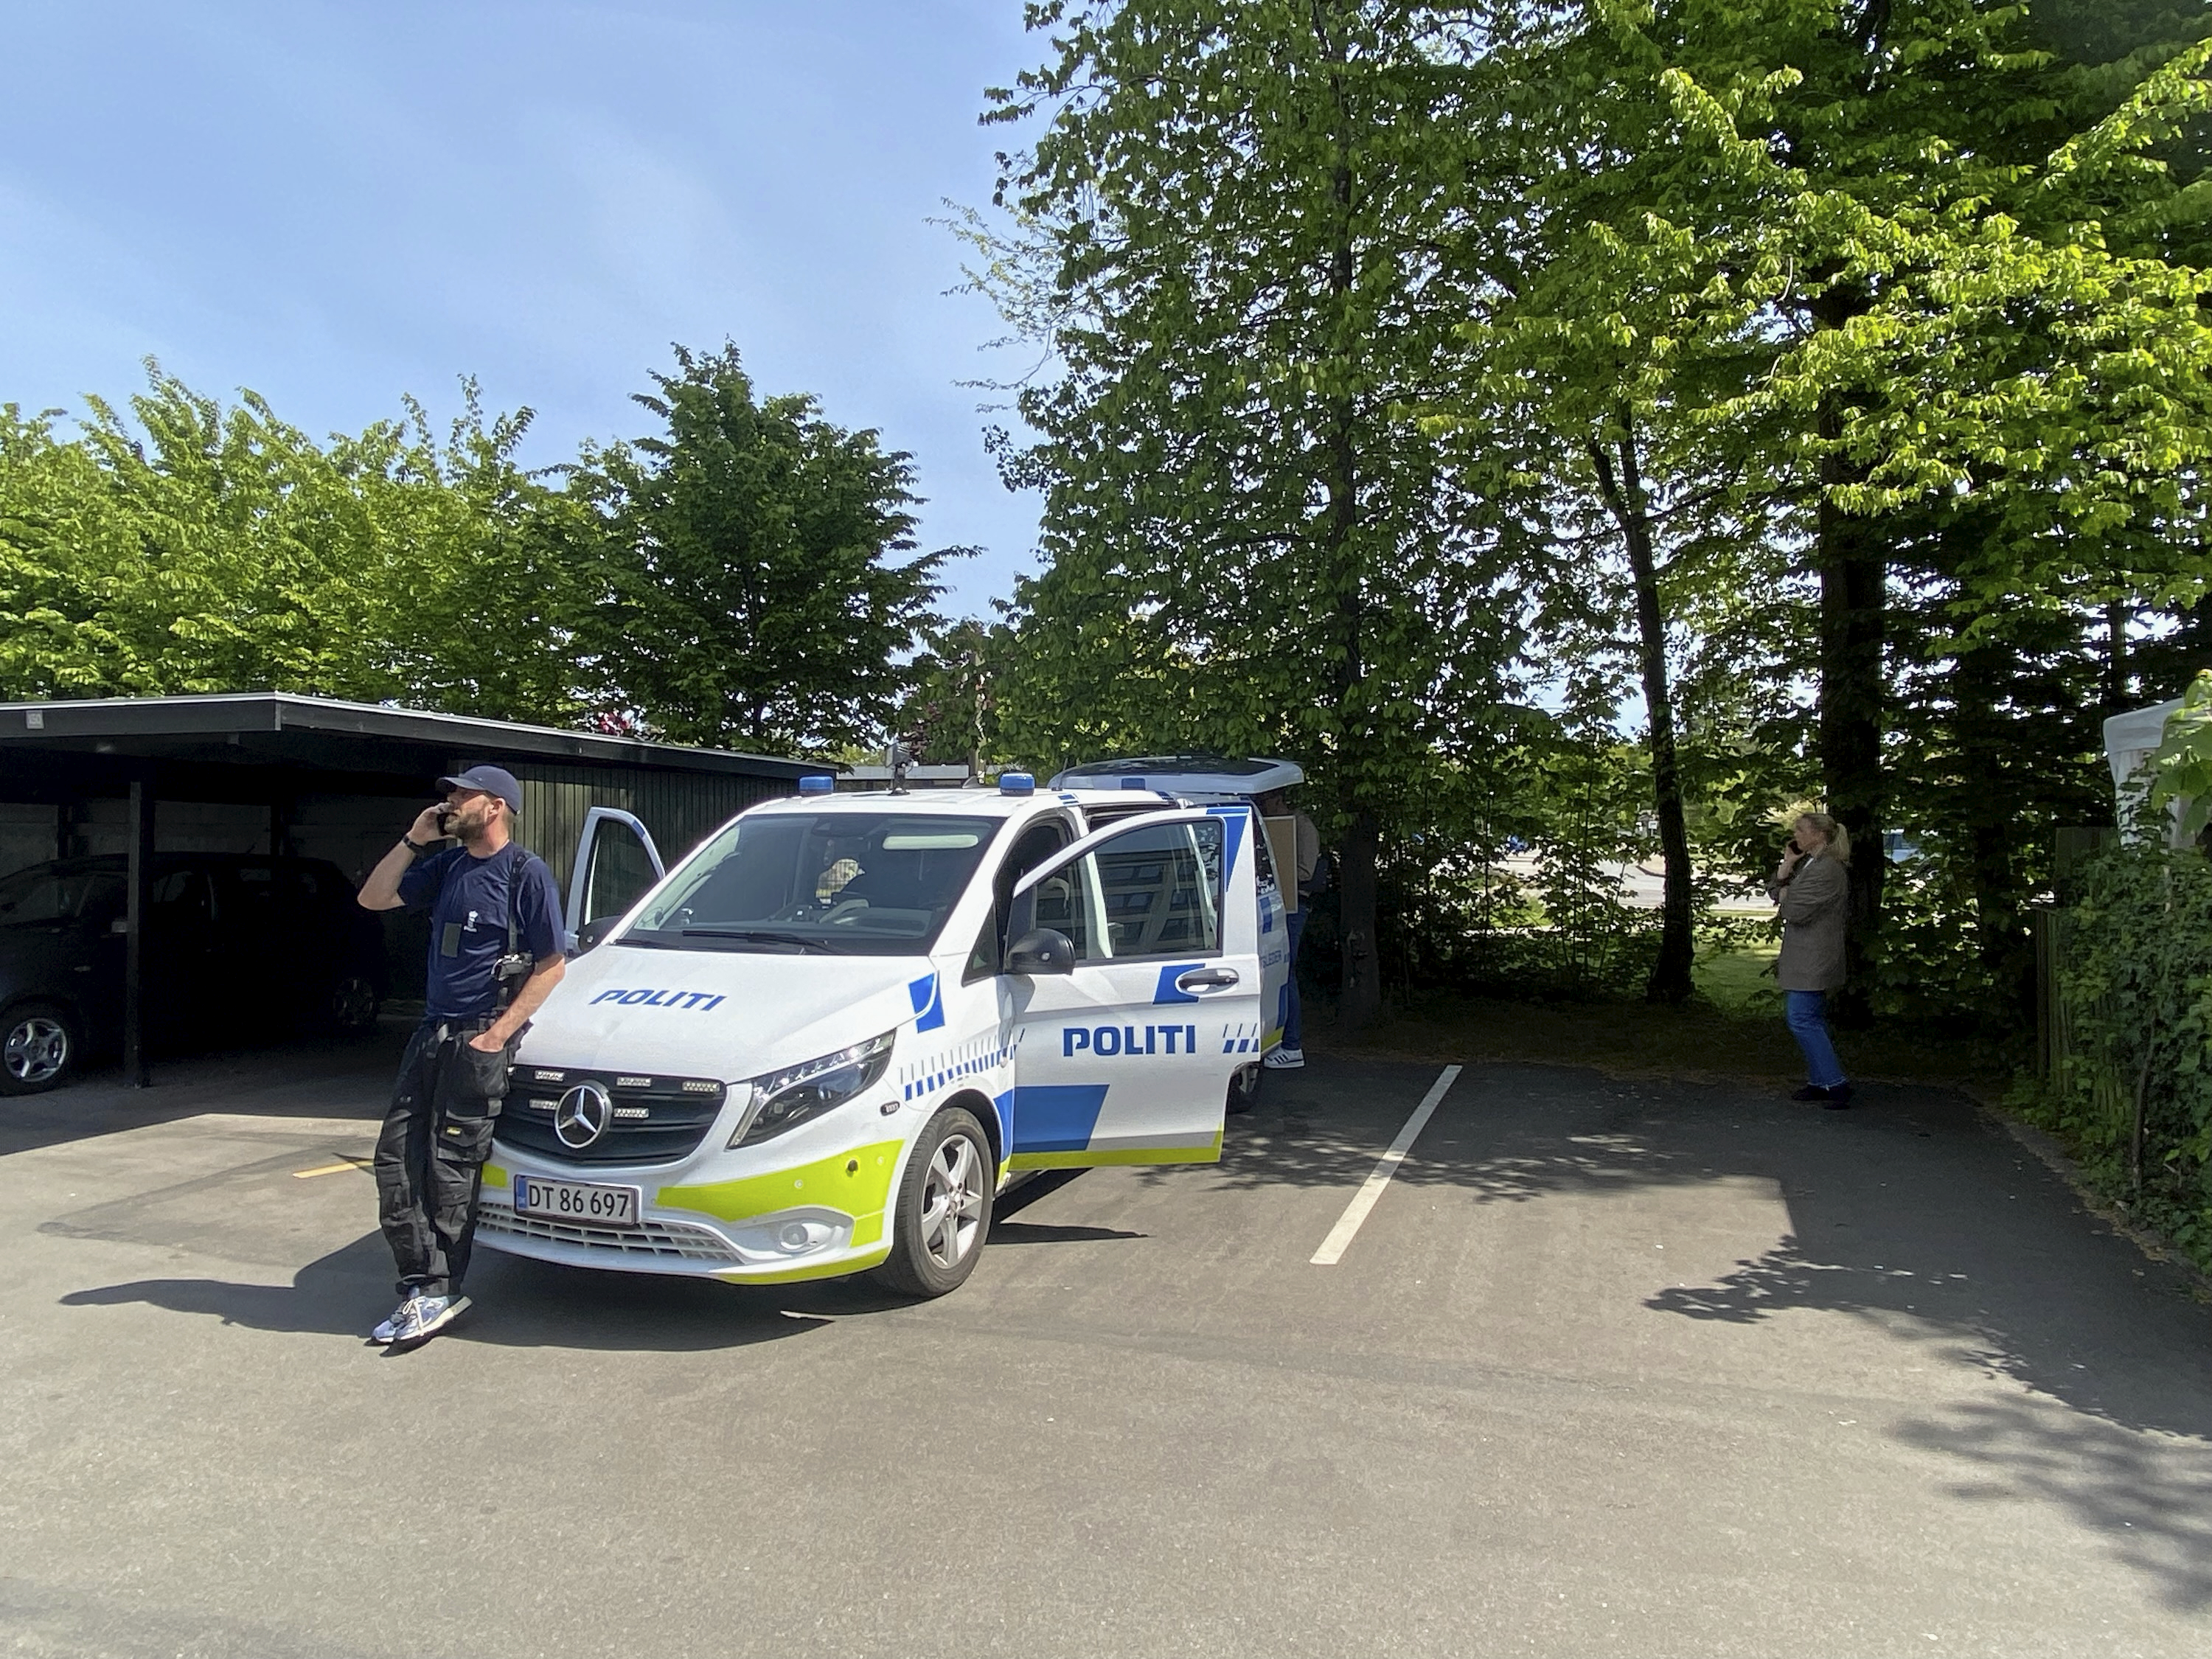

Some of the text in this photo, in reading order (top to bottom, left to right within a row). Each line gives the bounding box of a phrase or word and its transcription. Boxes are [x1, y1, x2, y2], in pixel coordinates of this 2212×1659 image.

[588, 990, 727, 1011] POLITI
[1063, 1025, 1195, 1057] POLITI
[529, 1185, 629, 1217] DT 86 697
